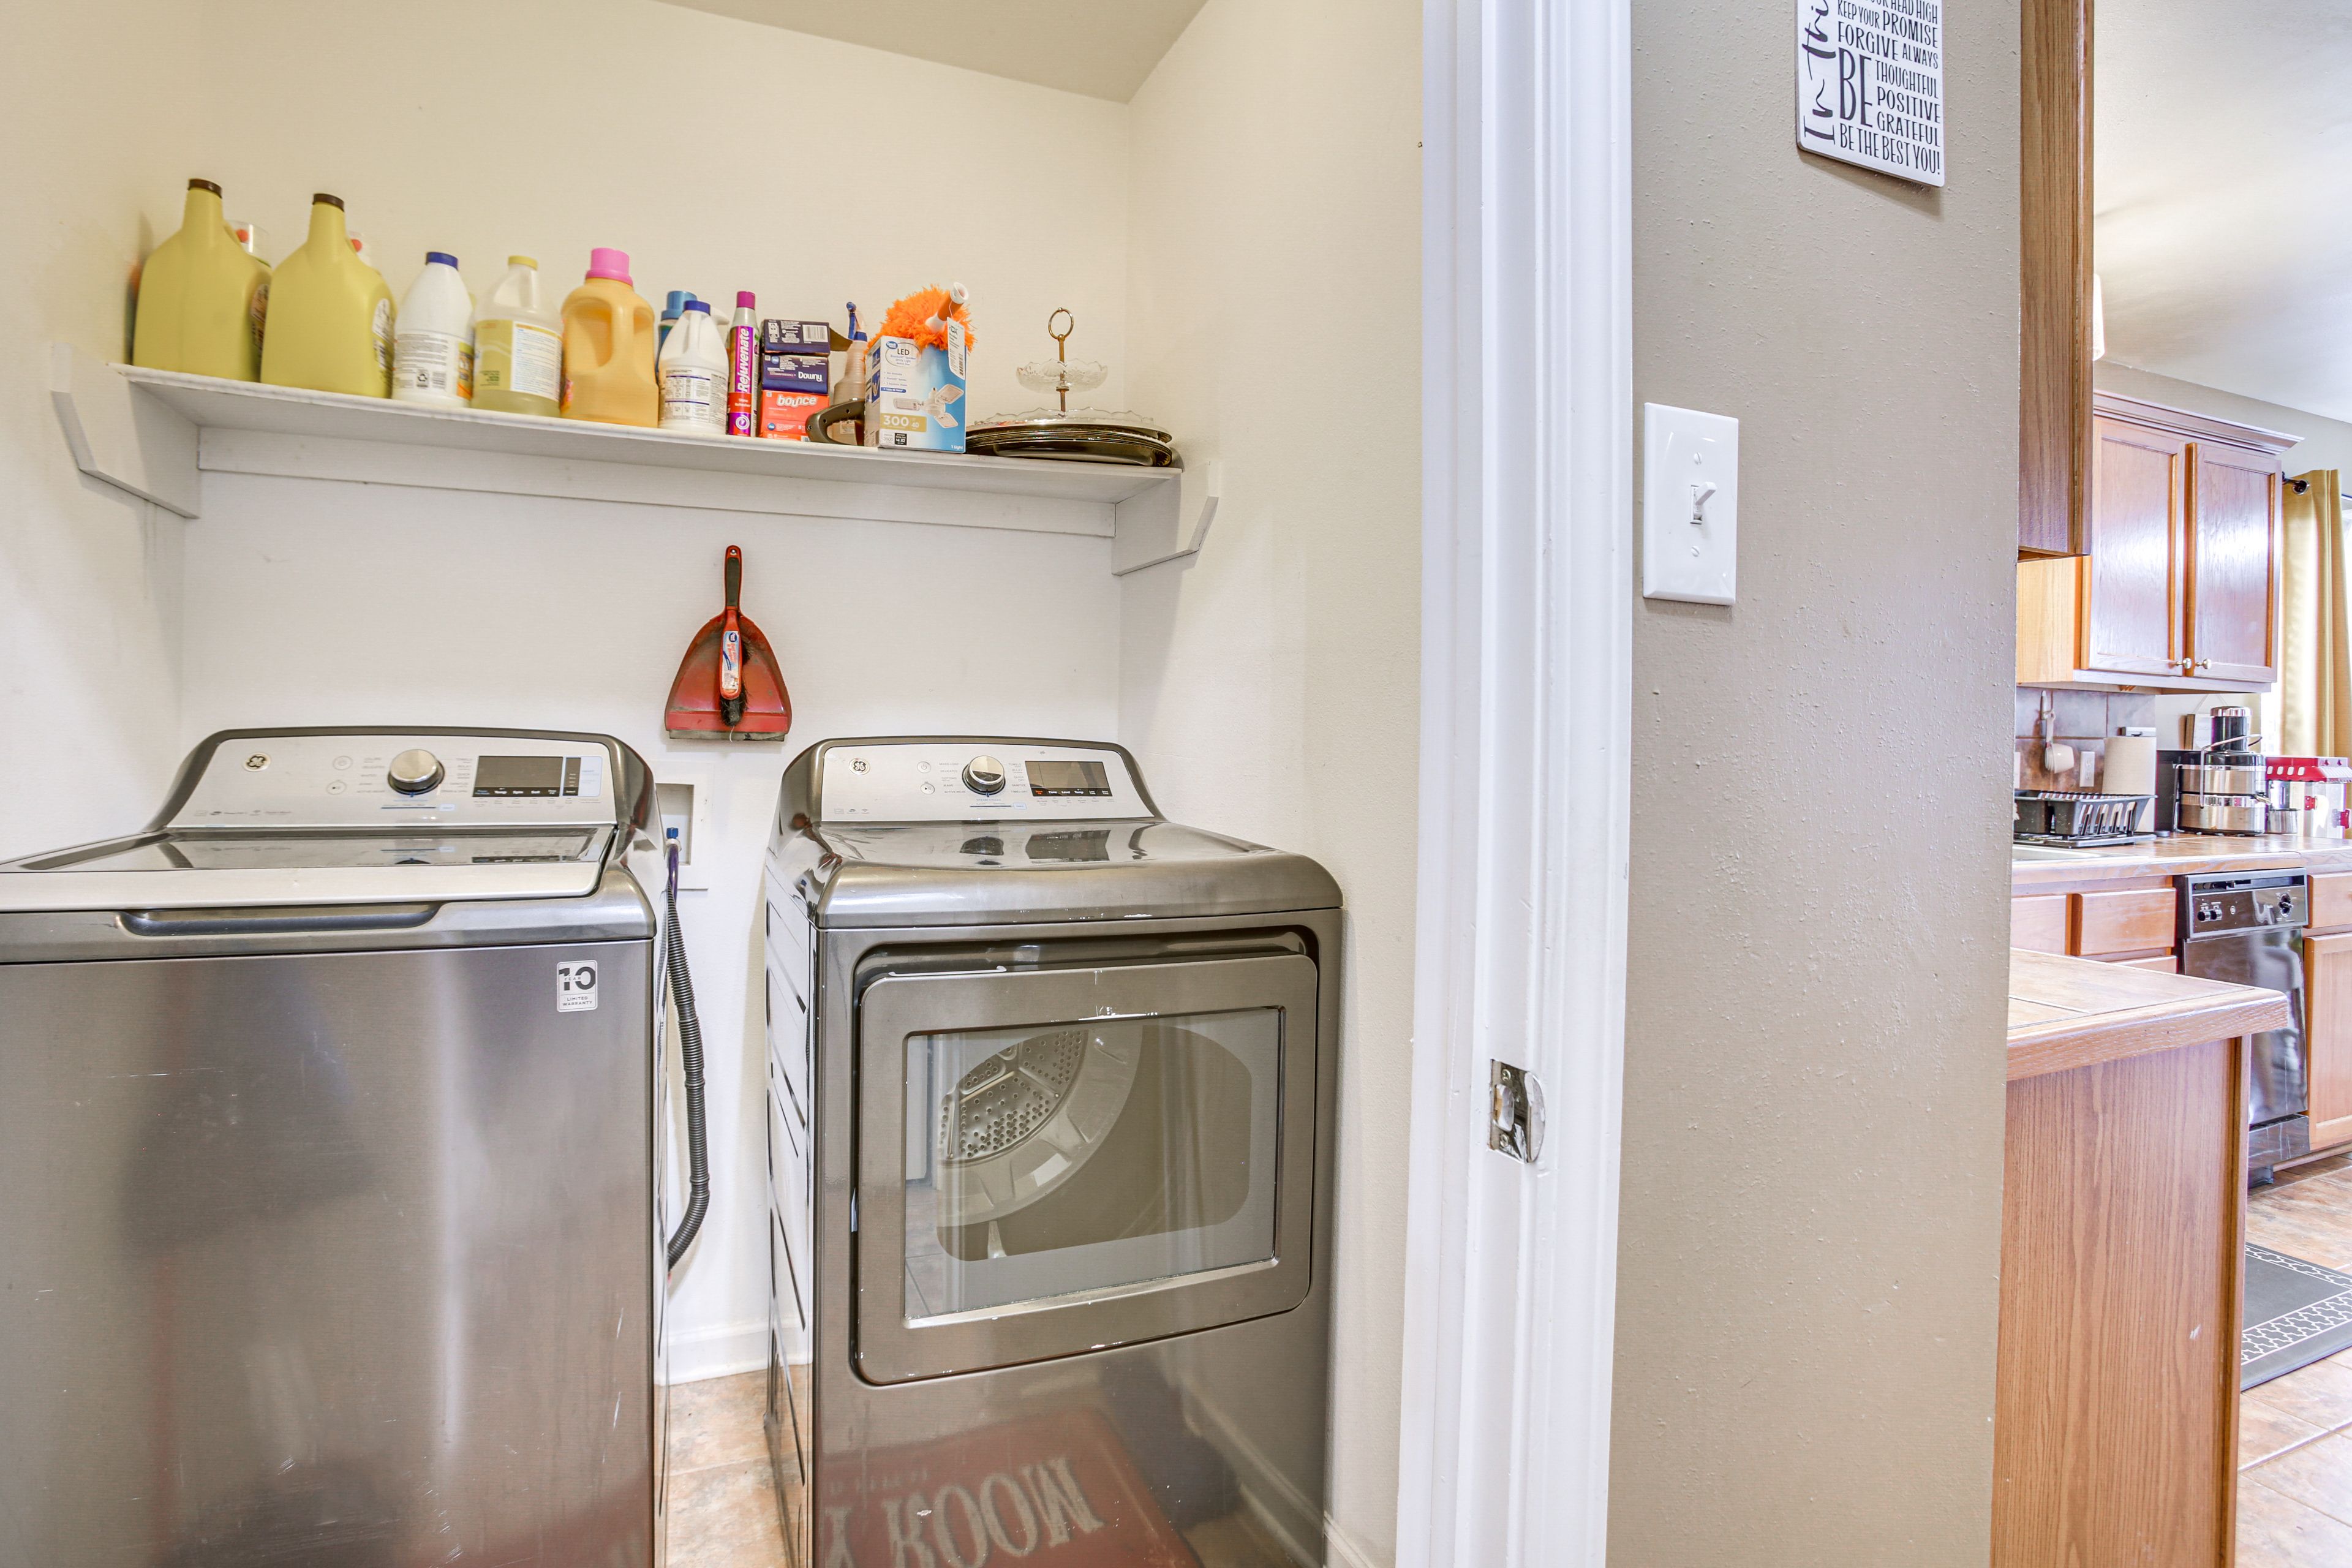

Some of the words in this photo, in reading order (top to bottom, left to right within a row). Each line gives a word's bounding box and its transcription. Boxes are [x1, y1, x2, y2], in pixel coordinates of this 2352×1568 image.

[1838, 1, 1857, 22] KEEP
[1859, 7, 1880, 29] YOUR
[1883, 10, 1939, 49] PROMISE
[1916, 0, 1938, 24] HIGH
[1801, 0, 1836, 81] Thi
[1838, 21, 1899, 61] FORGIVE
[1902, 43, 1939, 69] ALWAYS
[1839, 47, 1873, 128] BE
[1875, 59, 1939, 99] THOUGHTFUL
[1877, 86, 1940, 124] POSITIVE
[1840, 123, 1854, 151] BE
[1856, 128, 1879, 158] THE
[1882, 135, 1910, 167] BEST
[1912, 145, 1940, 175] YOU!
[1877, 111, 1940, 148] GRATEFUL
[737, 328, 750, 393] Rejuvenate
[798, 371, 823, 382] Downy
[777, 394, 818, 408] bounce
[883, 415, 910, 427] 300
[559, 966, 596, 991] 10
